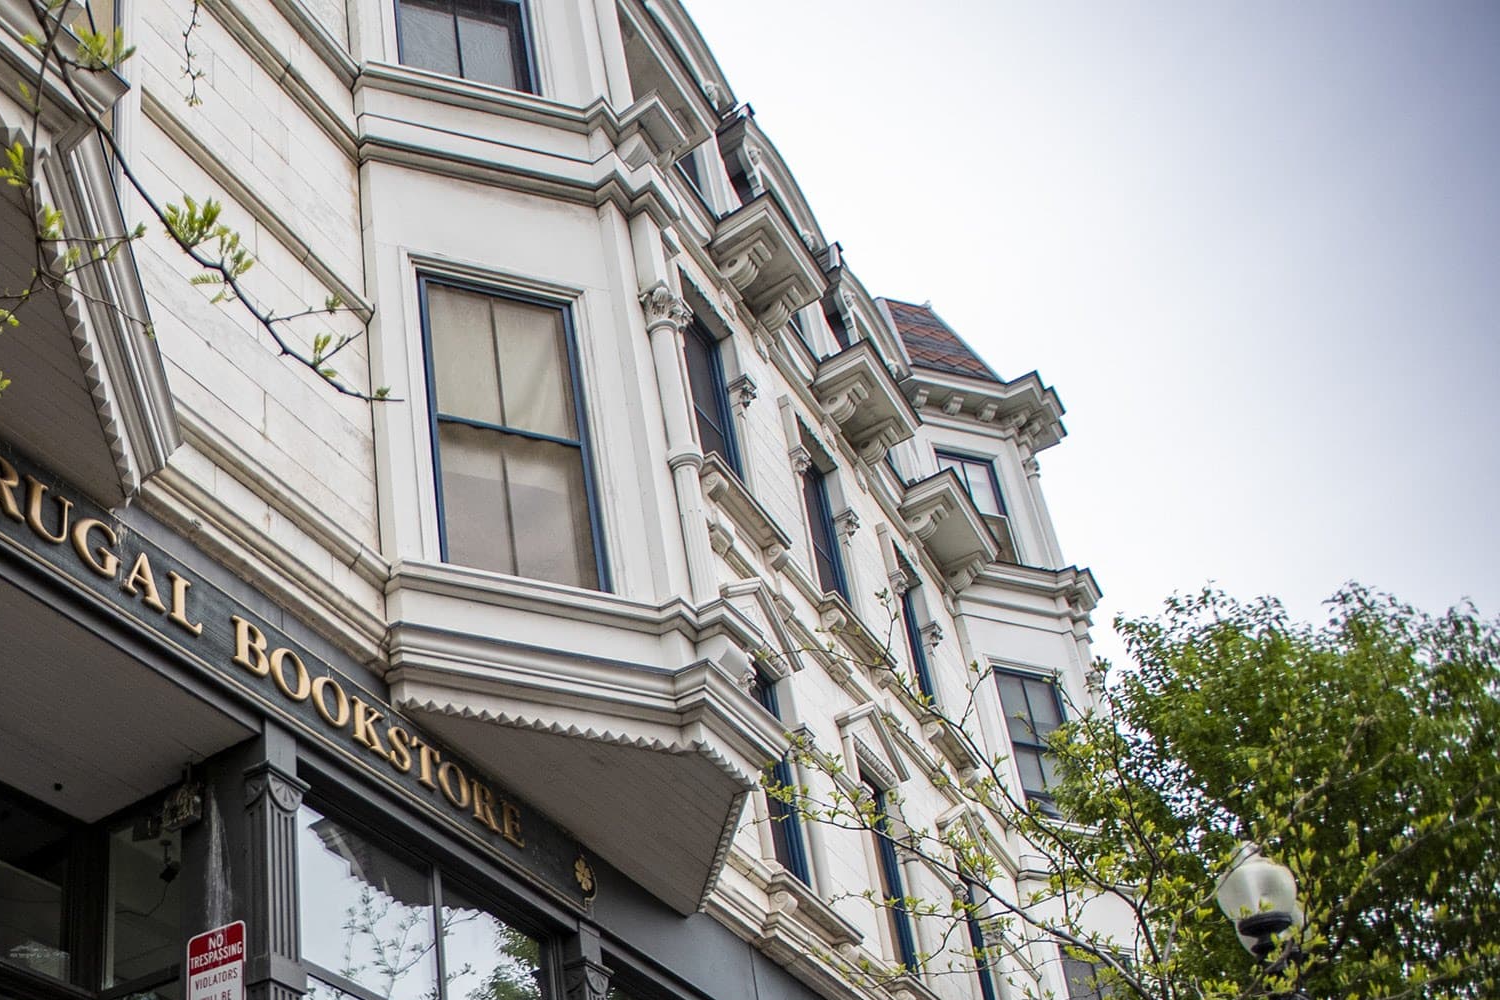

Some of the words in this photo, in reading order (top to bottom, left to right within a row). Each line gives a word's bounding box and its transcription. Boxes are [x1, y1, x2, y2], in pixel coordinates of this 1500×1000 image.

[231, 615, 526, 849] BOOKSTORE
[208, 933, 224, 950] NO
[190, 941, 243, 970] TRESPASSING
[195, 967, 238, 990] VIOLATORS
